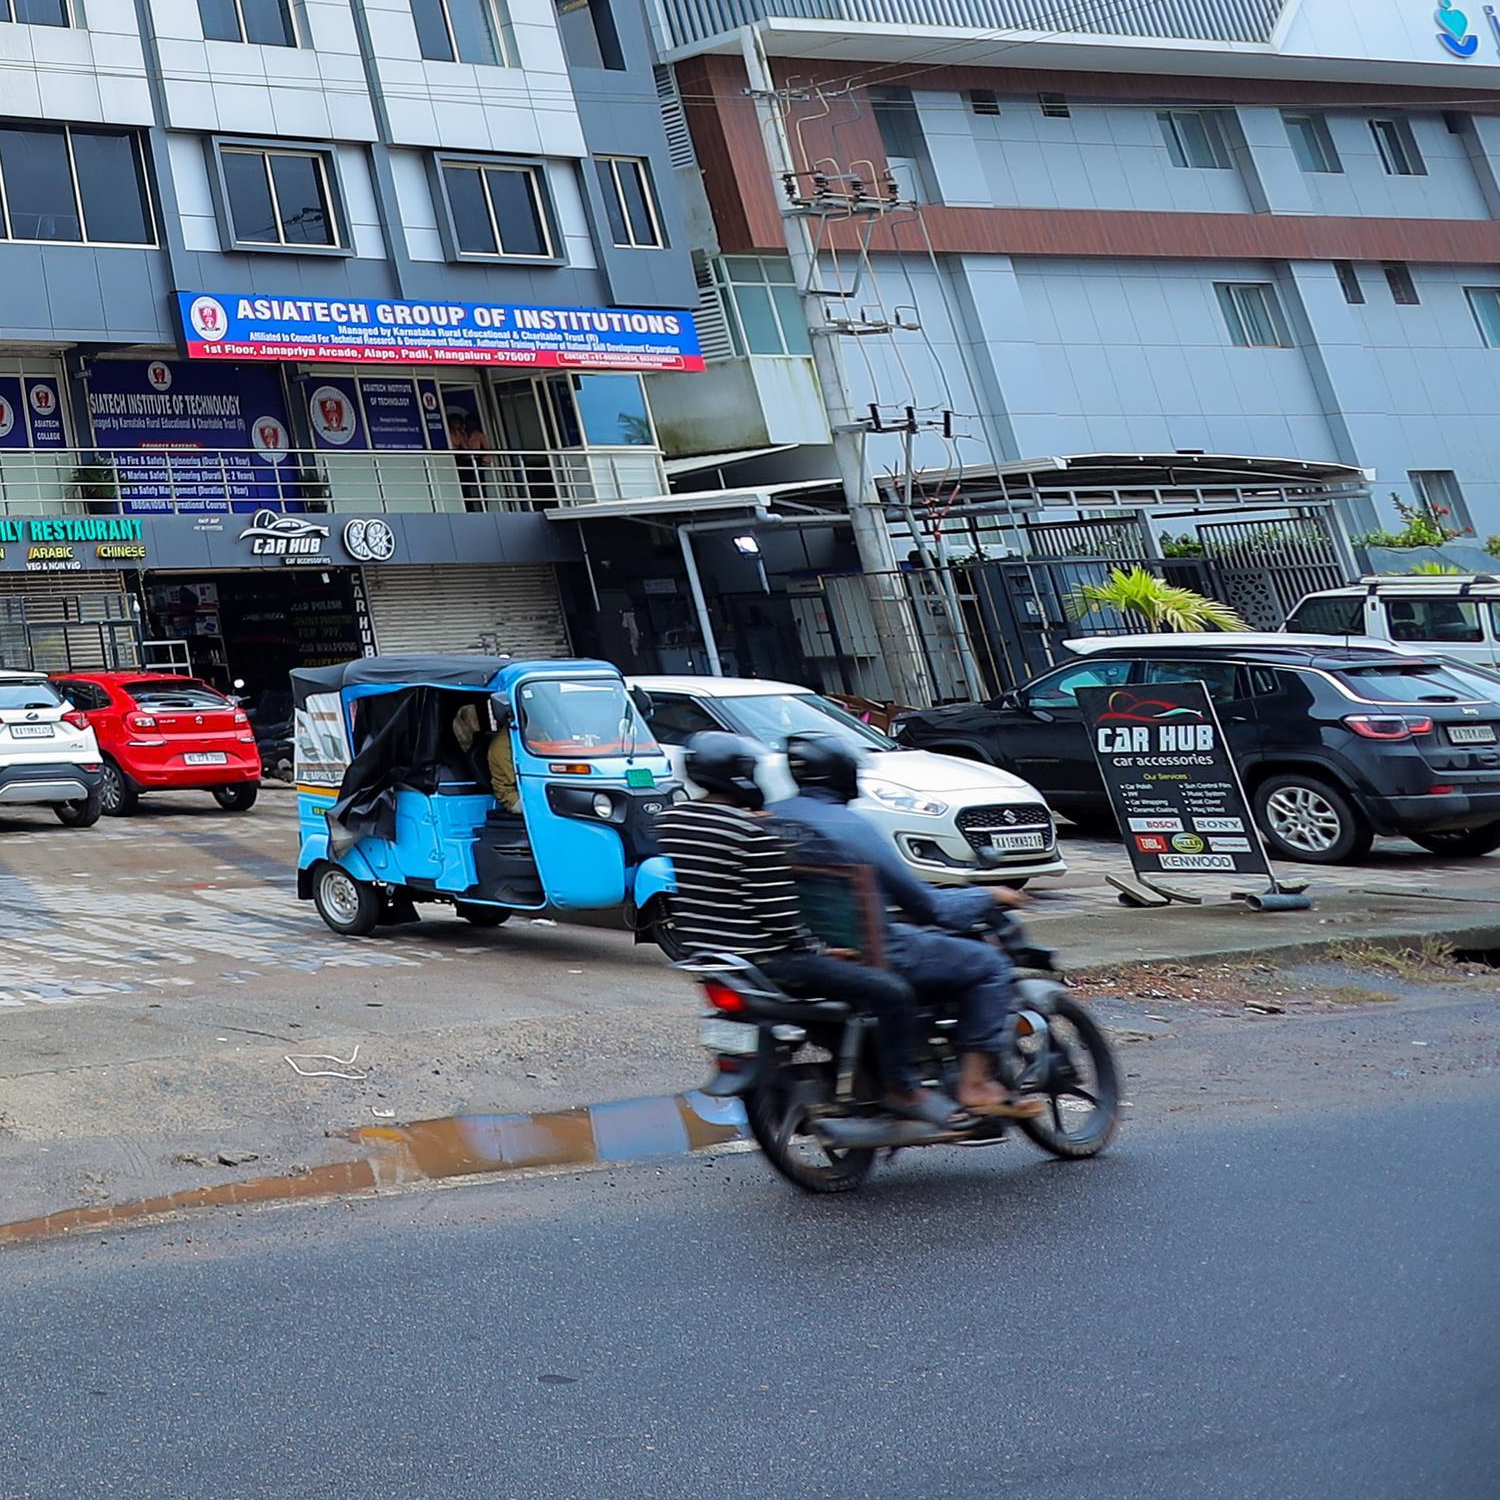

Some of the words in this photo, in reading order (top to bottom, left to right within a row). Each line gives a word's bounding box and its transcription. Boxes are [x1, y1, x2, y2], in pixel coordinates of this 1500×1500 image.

[237, 299, 369, 323] ASIATECH
[376, 304, 465, 326] GROUP
[473, 307, 506, 328] OF
[515, 310, 680, 335] INSTITUTIONS
[204, 344, 222, 354] 1st
[259, 346, 317, 358] Janapriya
[436, 351, 491, 362] Mangaluru
[30, 518, 144, 541] RESTAURANT
[29, 545, 74, 560] ARABIC
[98, 544, 146, 558] CHINESE
[253, 538, 287, 554] CAR
[289, 538, 321, 554] HUB
[1098, 727, 1149, 753] CAR
[1159, 725, 1214, 752] HUB
[1113, 757, 1133, 767] car
[1136, 754, 1214, 766] accessories
[1146, 820, 1178, 829] BOSCH
[1196, 820, 1241, 829] SONY
[1162, 856, 1231, 868] KENWOOD
